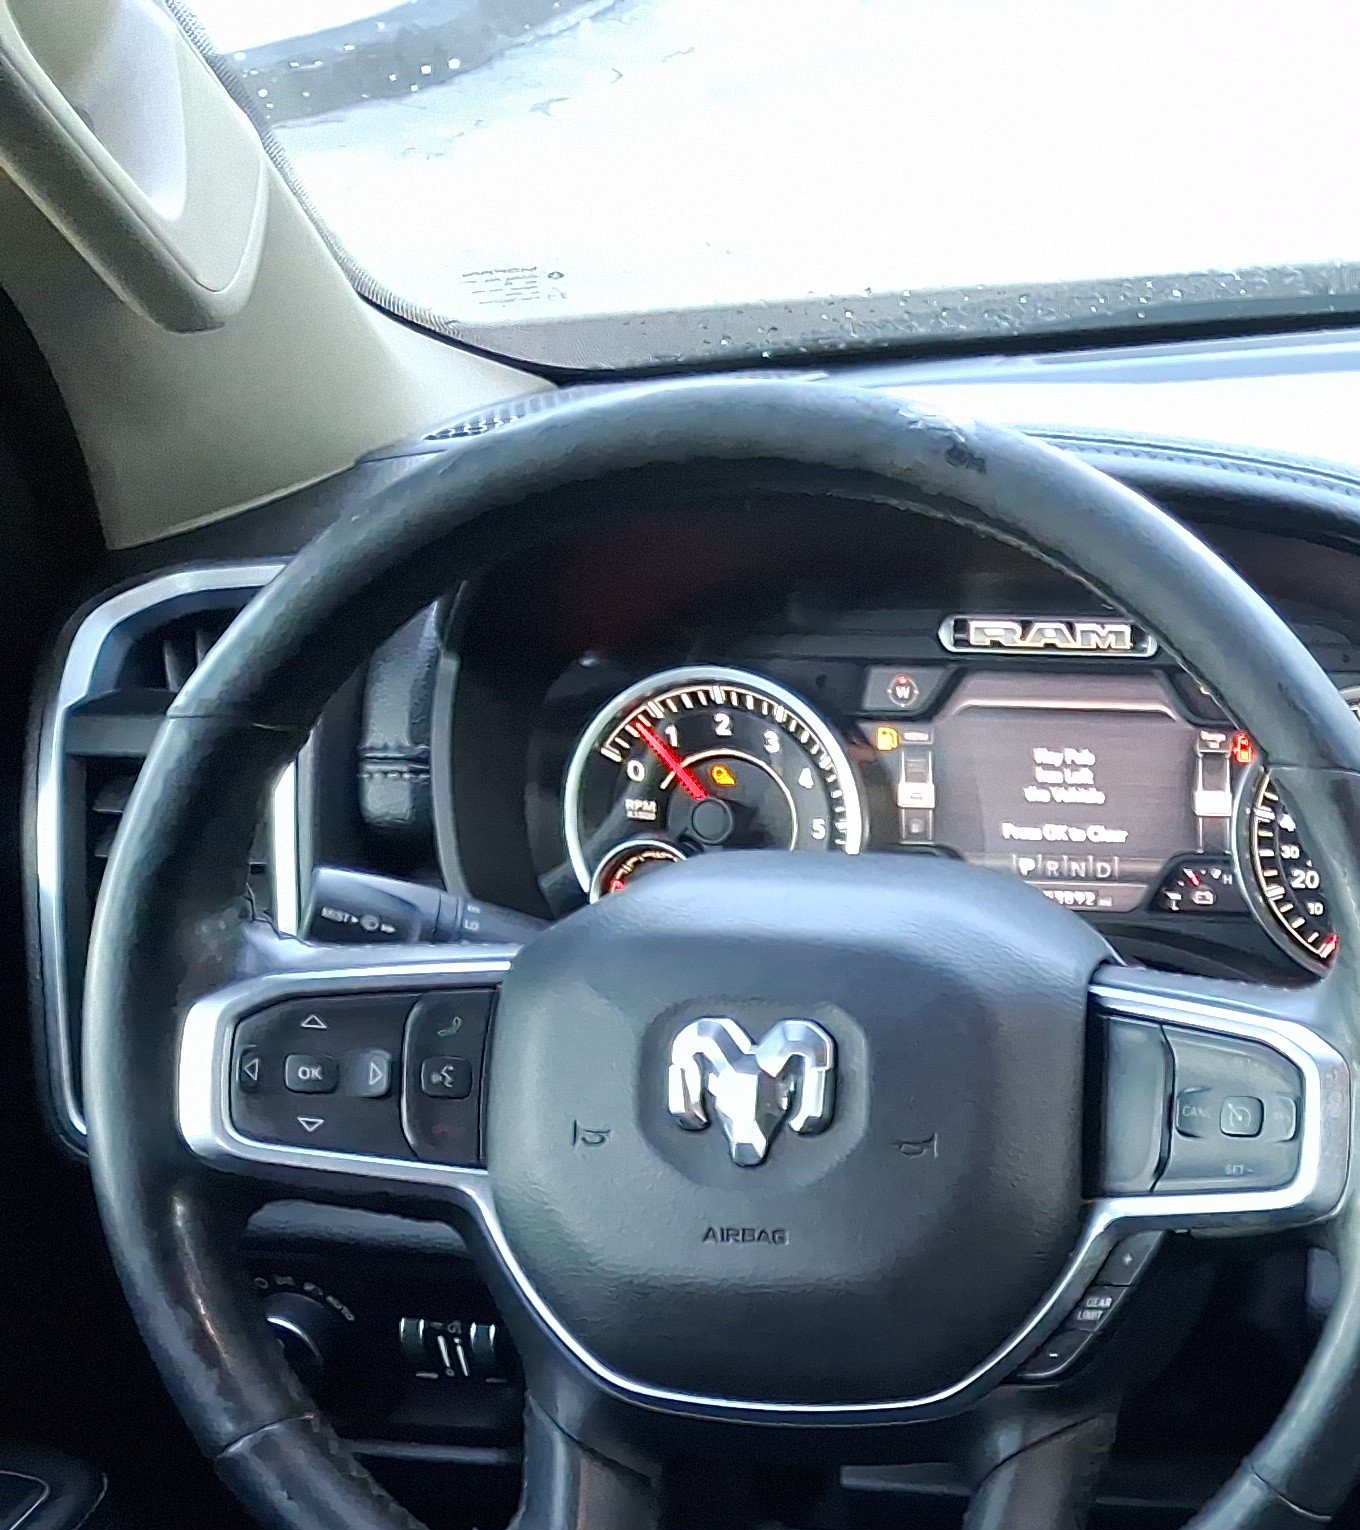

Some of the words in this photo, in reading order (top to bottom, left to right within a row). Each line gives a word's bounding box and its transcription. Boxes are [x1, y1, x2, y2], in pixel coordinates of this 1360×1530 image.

[968, 619, 1132, 649] RAM
[713, 712, 733, 737] 2
[664, 725, 680, 747] 1
[763, 730, 781, 754] 3
[626, 759, 646, 782] 0
[811, 817, 827, 840] 5
[1280, 843, 1301, 860] 30
[1045, 860, 1060, 877] R
[1070, 861, 1087, 878] N
[1096, 861, 1112, 878] D
[1289, 867, 1320, 889] 20
[1306, 901, 1324, 916] 10
[298, 1065, 324, 1081] OK
[702, 1226, 788, 1245] AIRBAG
